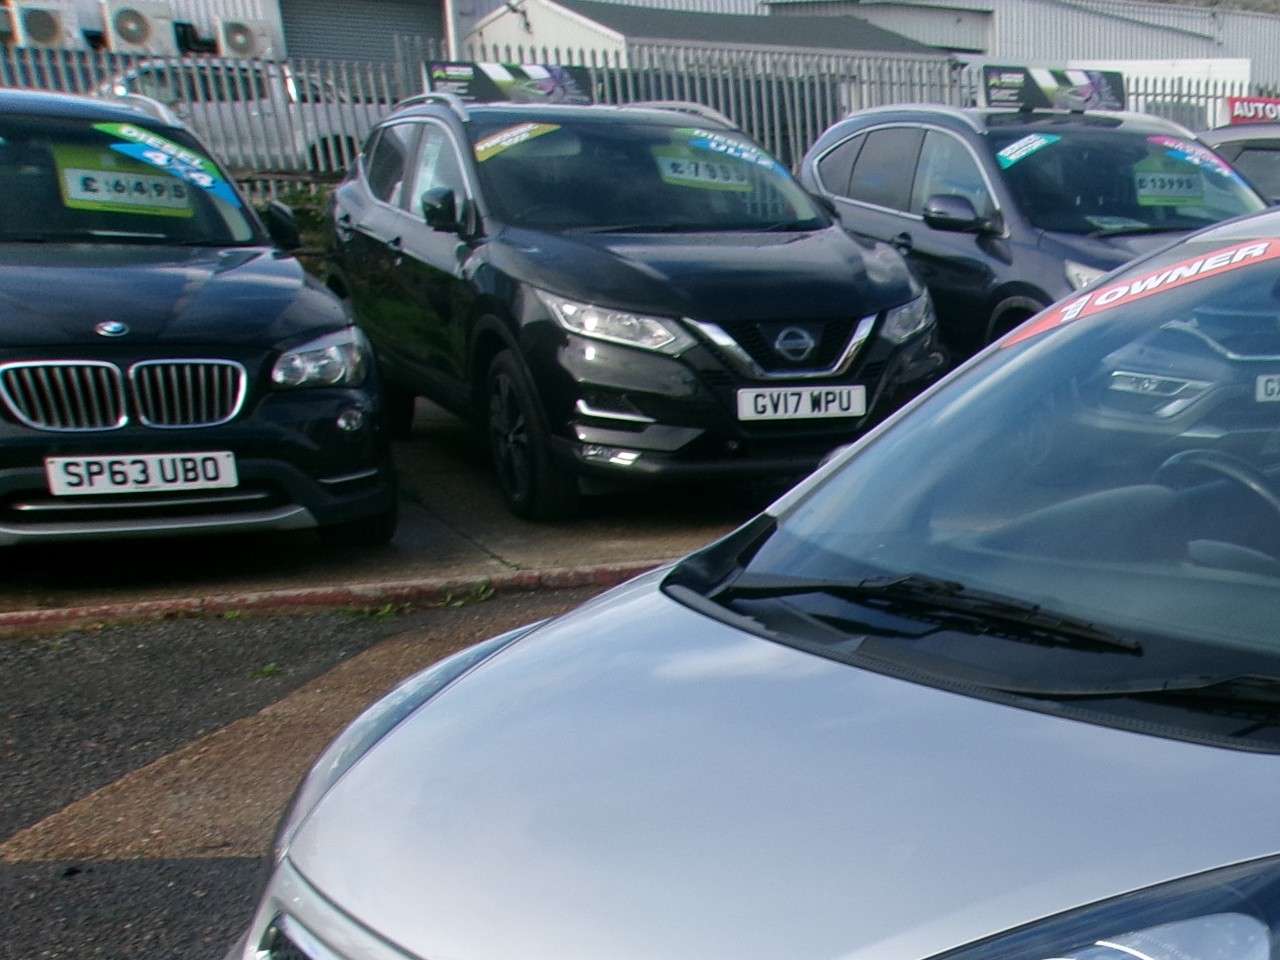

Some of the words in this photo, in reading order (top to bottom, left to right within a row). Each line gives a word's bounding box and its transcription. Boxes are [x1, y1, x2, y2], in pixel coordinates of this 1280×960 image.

[119, 124, 203, 169] DIESEL
[1093, 241, 1273, 306] OWNER
[753, 392, 803, 415] GV17
[810, 390, 852, 412] WPU
[63, 459, 151, 488] SP63
[158, 456, 220, 484] UBO
